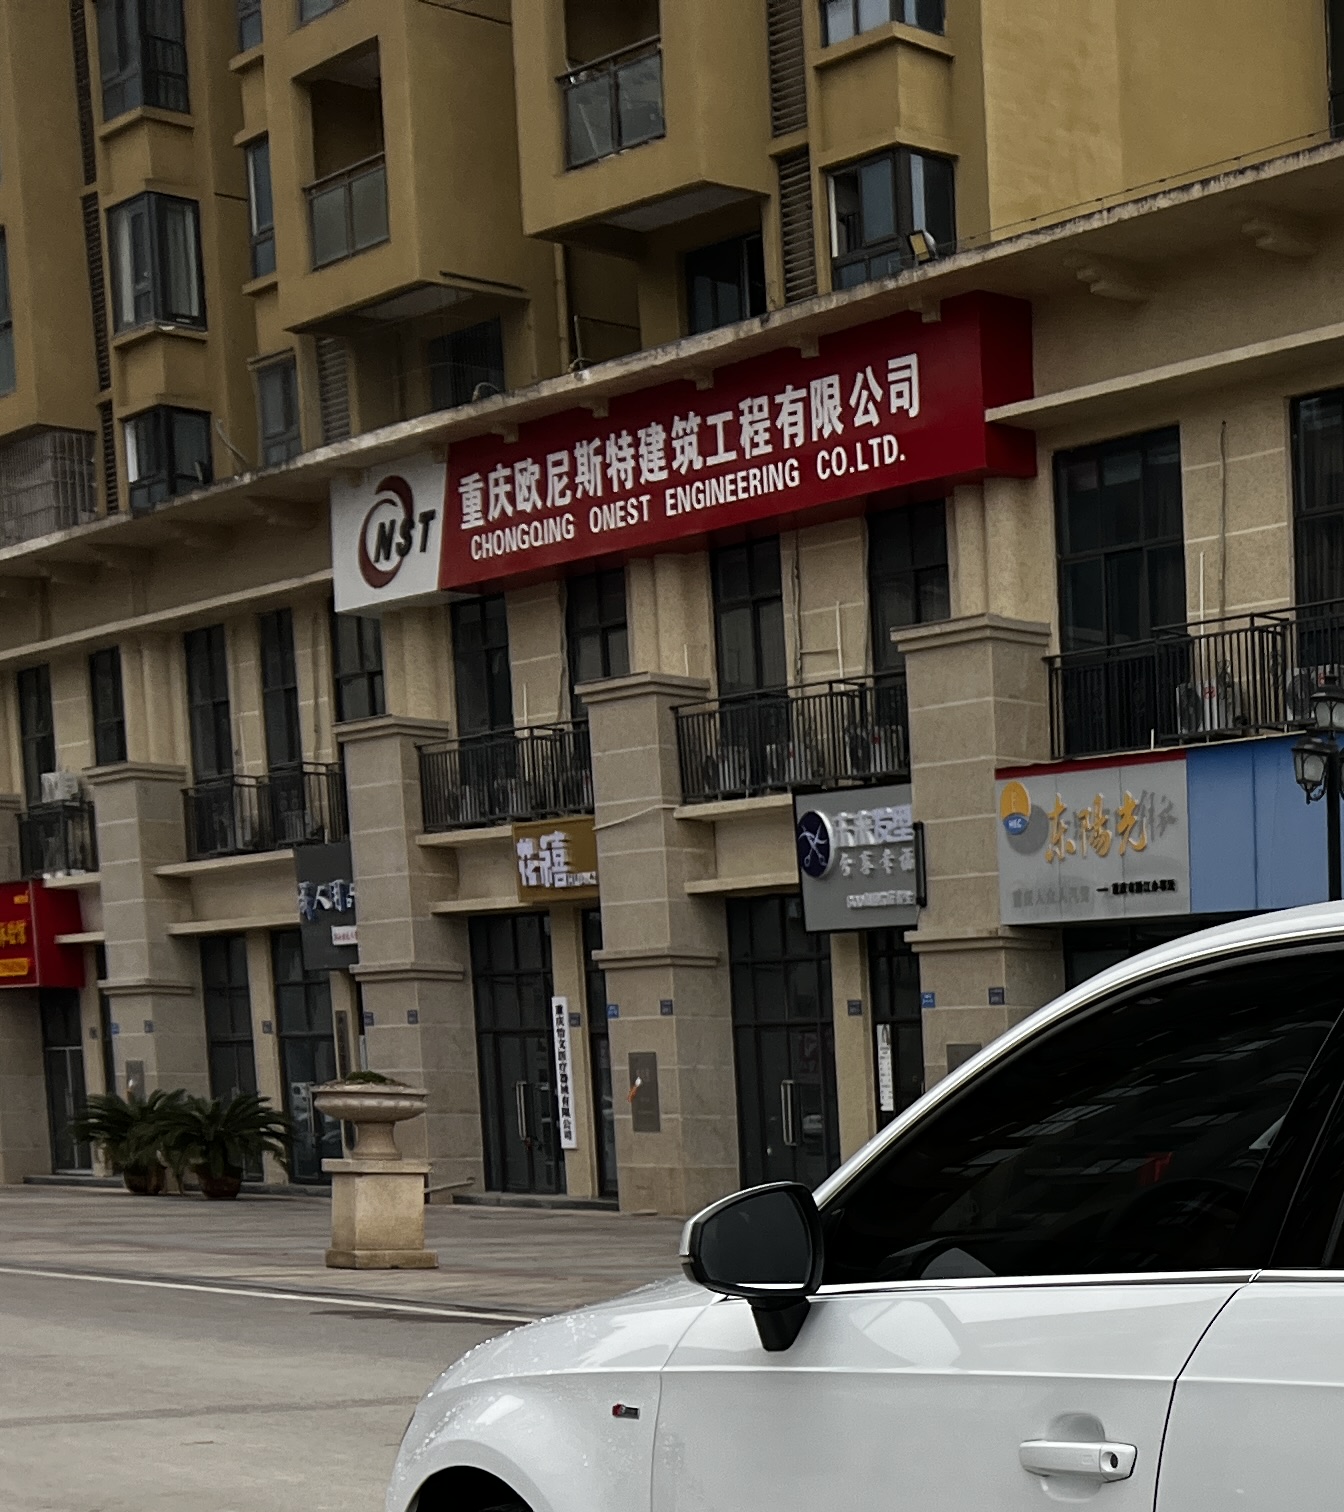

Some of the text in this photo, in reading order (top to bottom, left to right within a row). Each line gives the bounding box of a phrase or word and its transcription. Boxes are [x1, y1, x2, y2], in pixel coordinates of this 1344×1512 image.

[458, 352, 920, 531] 重庆欧尼斯特建筑工程有限公司
[470, 512, 575, 561] CHONGQING
[589, 494, 651, 535] ONEST
[665, 458, 800, 517] ENGINEERING
